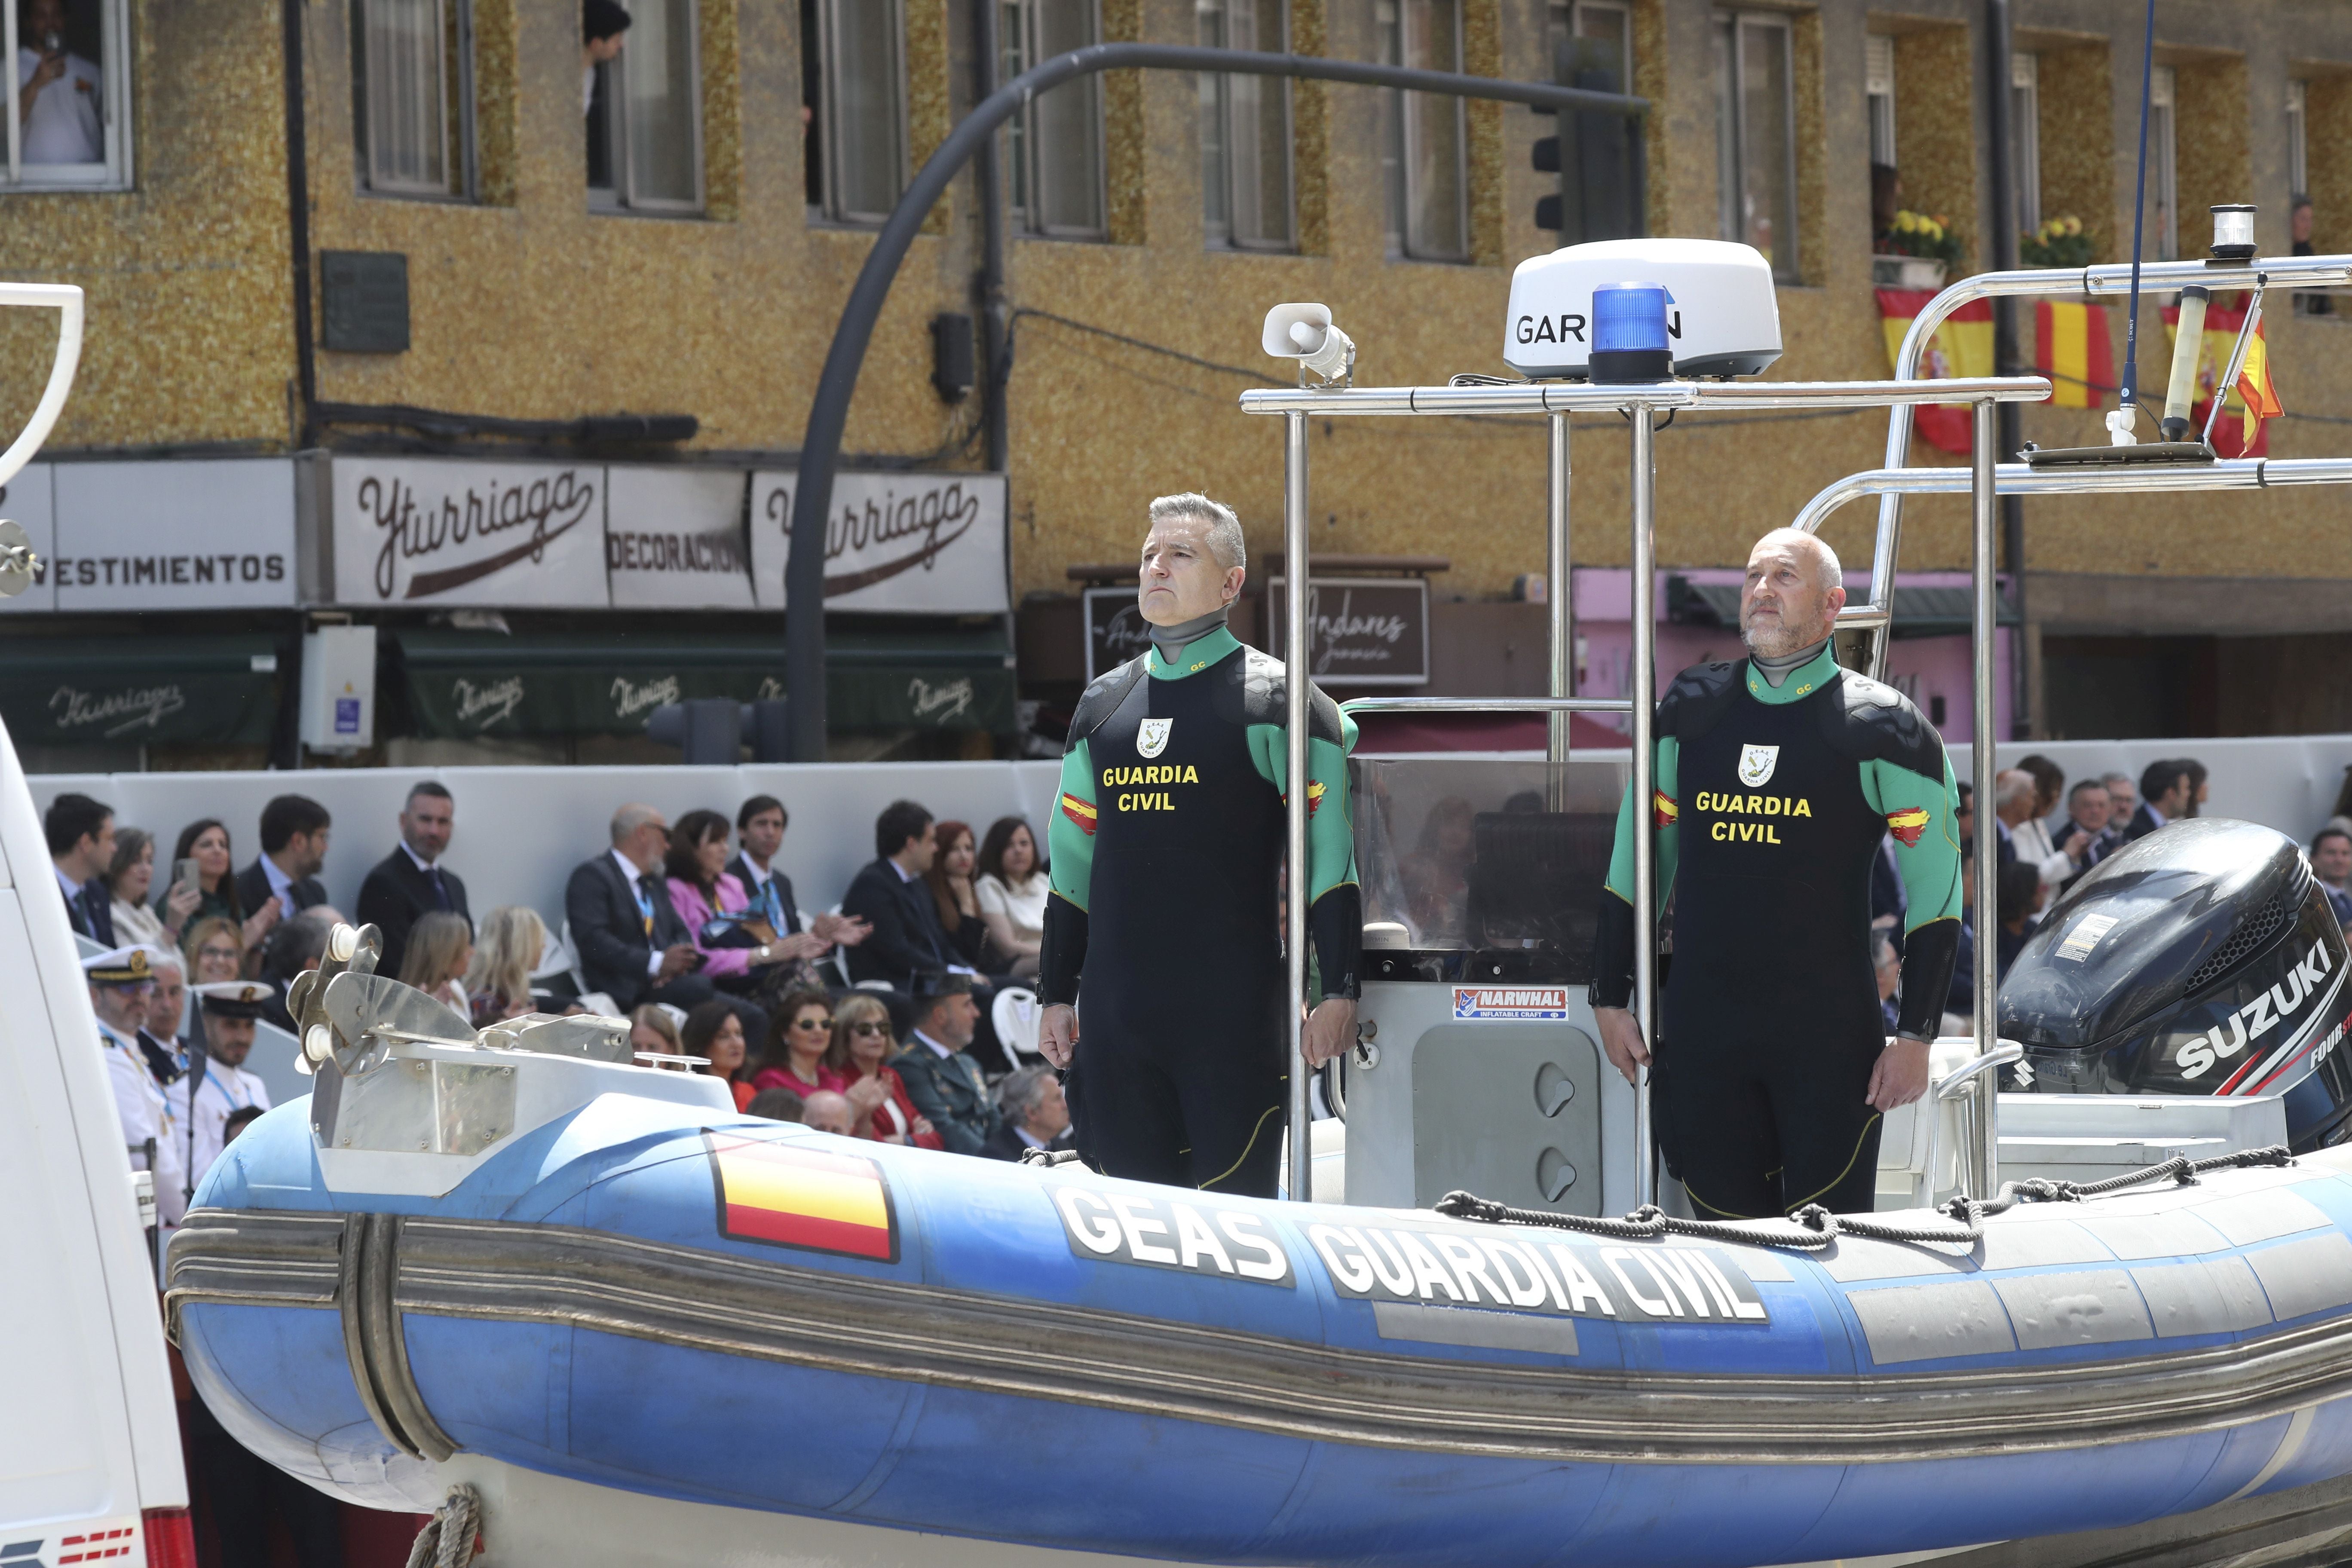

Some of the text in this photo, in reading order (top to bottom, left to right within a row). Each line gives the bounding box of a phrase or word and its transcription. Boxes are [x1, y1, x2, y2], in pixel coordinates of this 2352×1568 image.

[1516, 311, 1681, 343] GARN
[359, 471, 592, 598] Yturriaga
[1190, 661, 1206, 671] GC
[1750, 680, 1758, 692] GC
[1796, 683, 1812, 695] GC
[1140, 742, 1165, 755] GUARDIA CIVIL
[1103, 766, 1199, 787] GUARDIA
[1742, 769, 1770, 783] GUARDIA CIVIL
[1118, 793, 1175, 812] CIVIL
[1696, 791, 1812, 817] GUARDIA
[1711, 822, 1781, 845] CIVIL
[1480, 991, 1562, 1006] NARWHAL
[2176, 937, 2332, 1080] SUZUKI
[1056, 1186, 1287, 1280] GEAS
[1308, 1224, 1766, 1319] GUARDIA CIVIL
